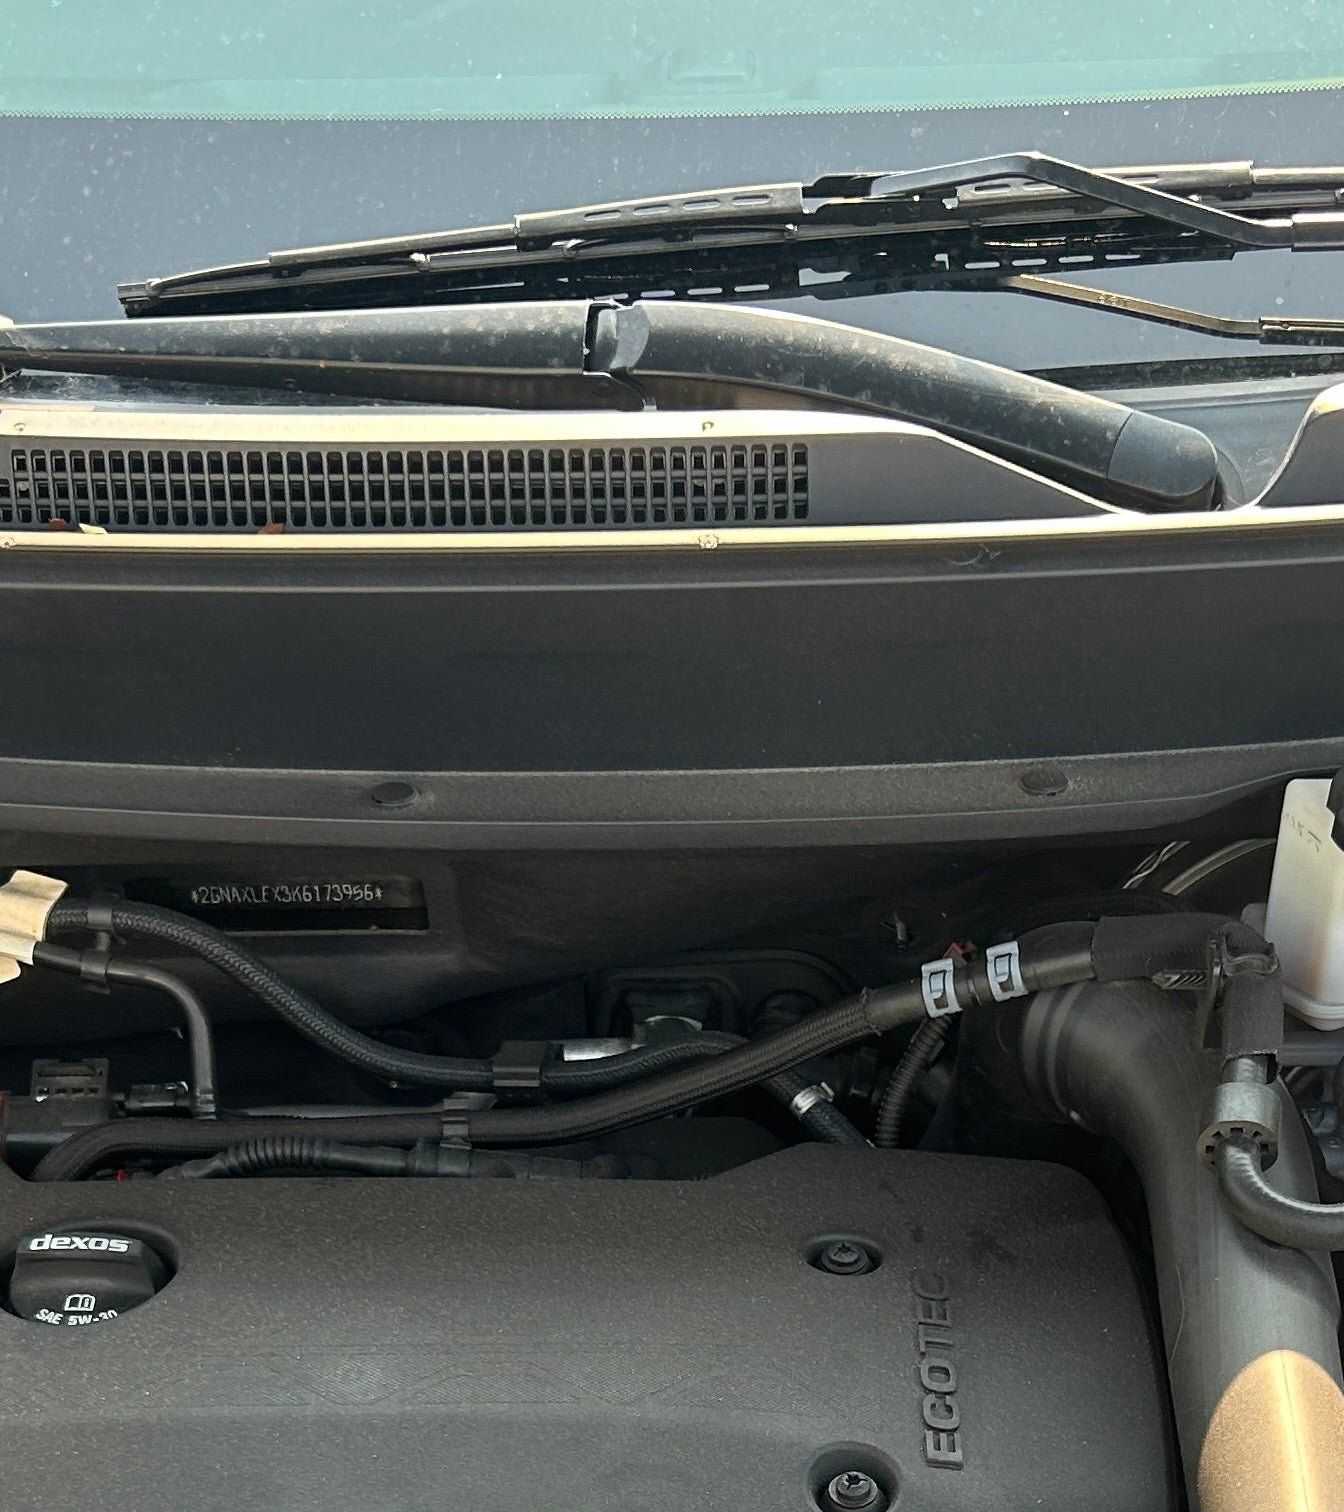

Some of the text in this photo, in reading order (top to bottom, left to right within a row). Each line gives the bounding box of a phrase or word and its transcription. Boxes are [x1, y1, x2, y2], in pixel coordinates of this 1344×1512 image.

[29, 1234, 132, 1253] dexos
[35, 1308, 64, 1325] SAE
[915, 1272, 964, 1471] ECOTEC
